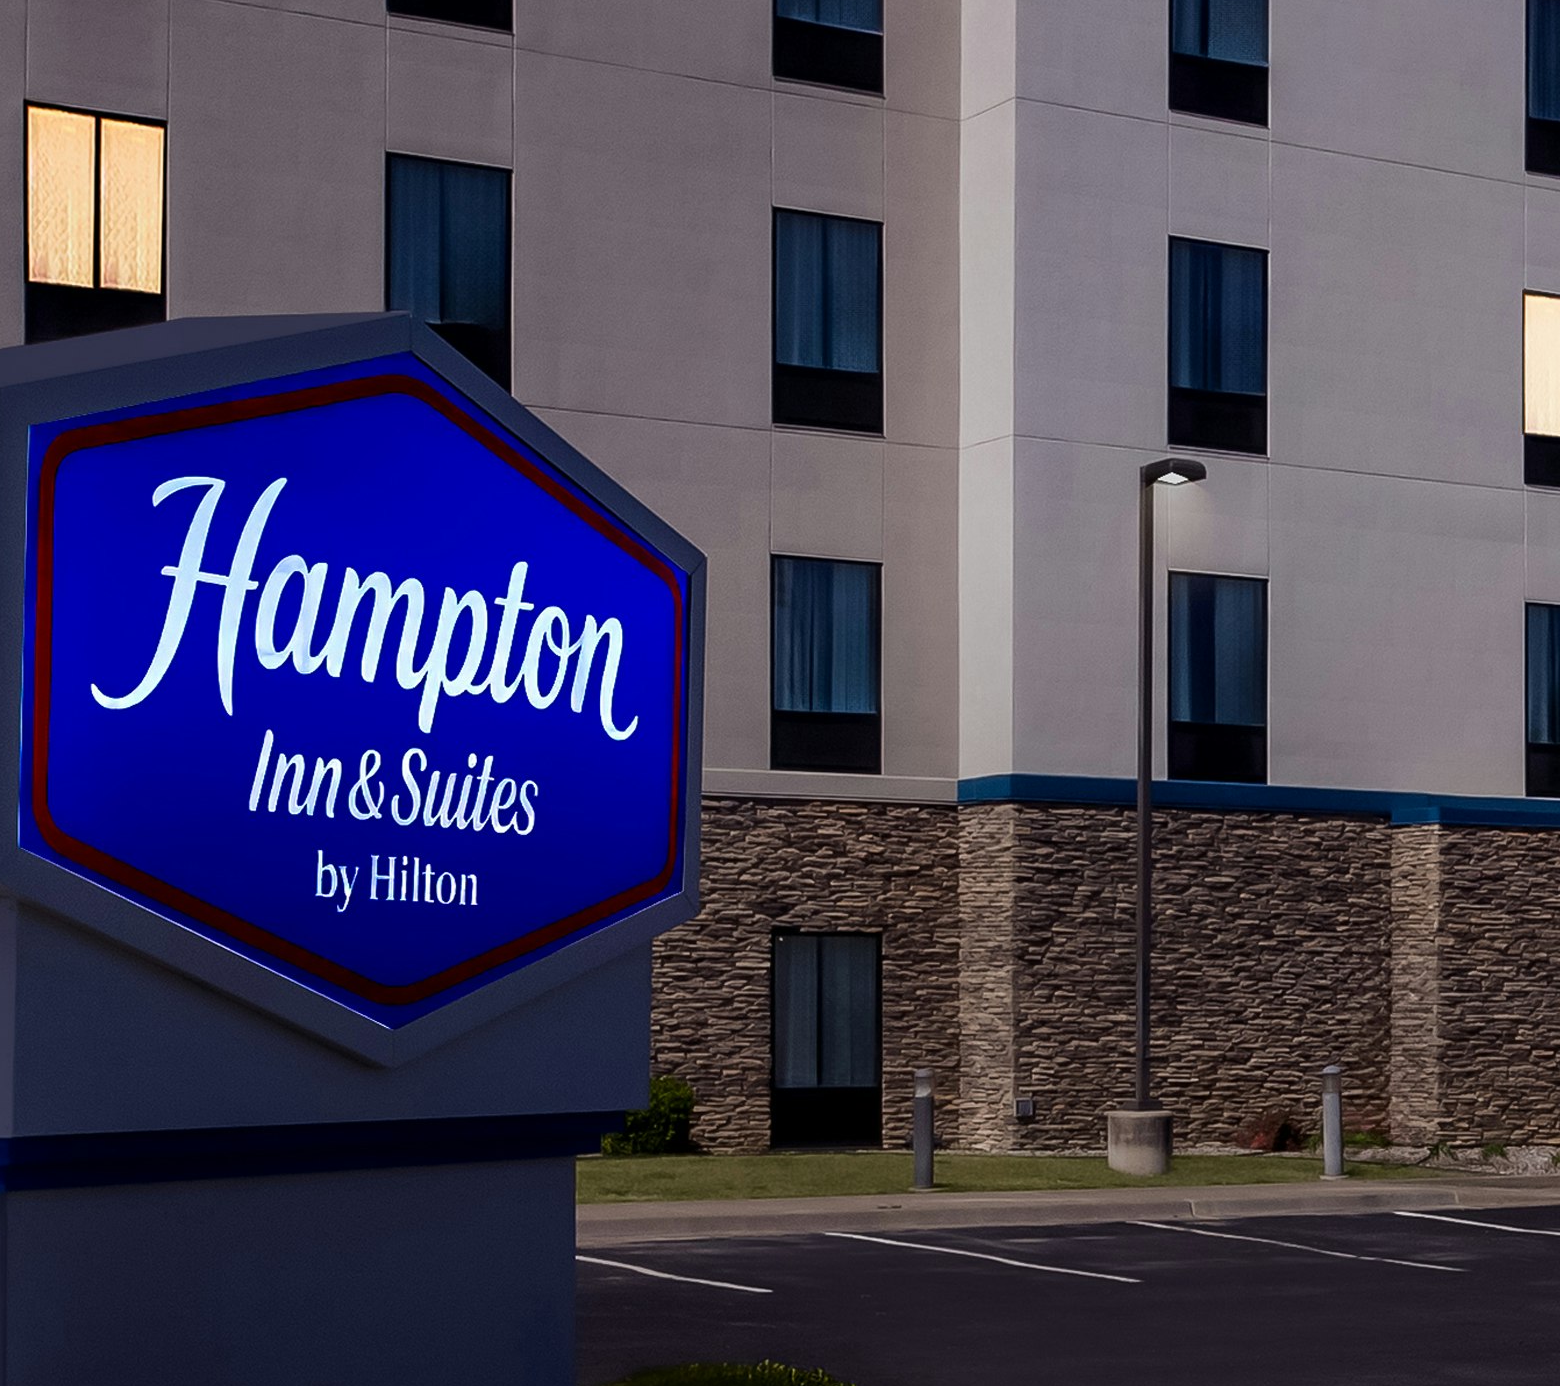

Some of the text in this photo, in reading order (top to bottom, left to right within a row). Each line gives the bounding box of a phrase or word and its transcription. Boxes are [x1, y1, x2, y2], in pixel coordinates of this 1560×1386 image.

[90, 476, 639, 741] Hampton
[315, 849, 479, 913] by Hilton
